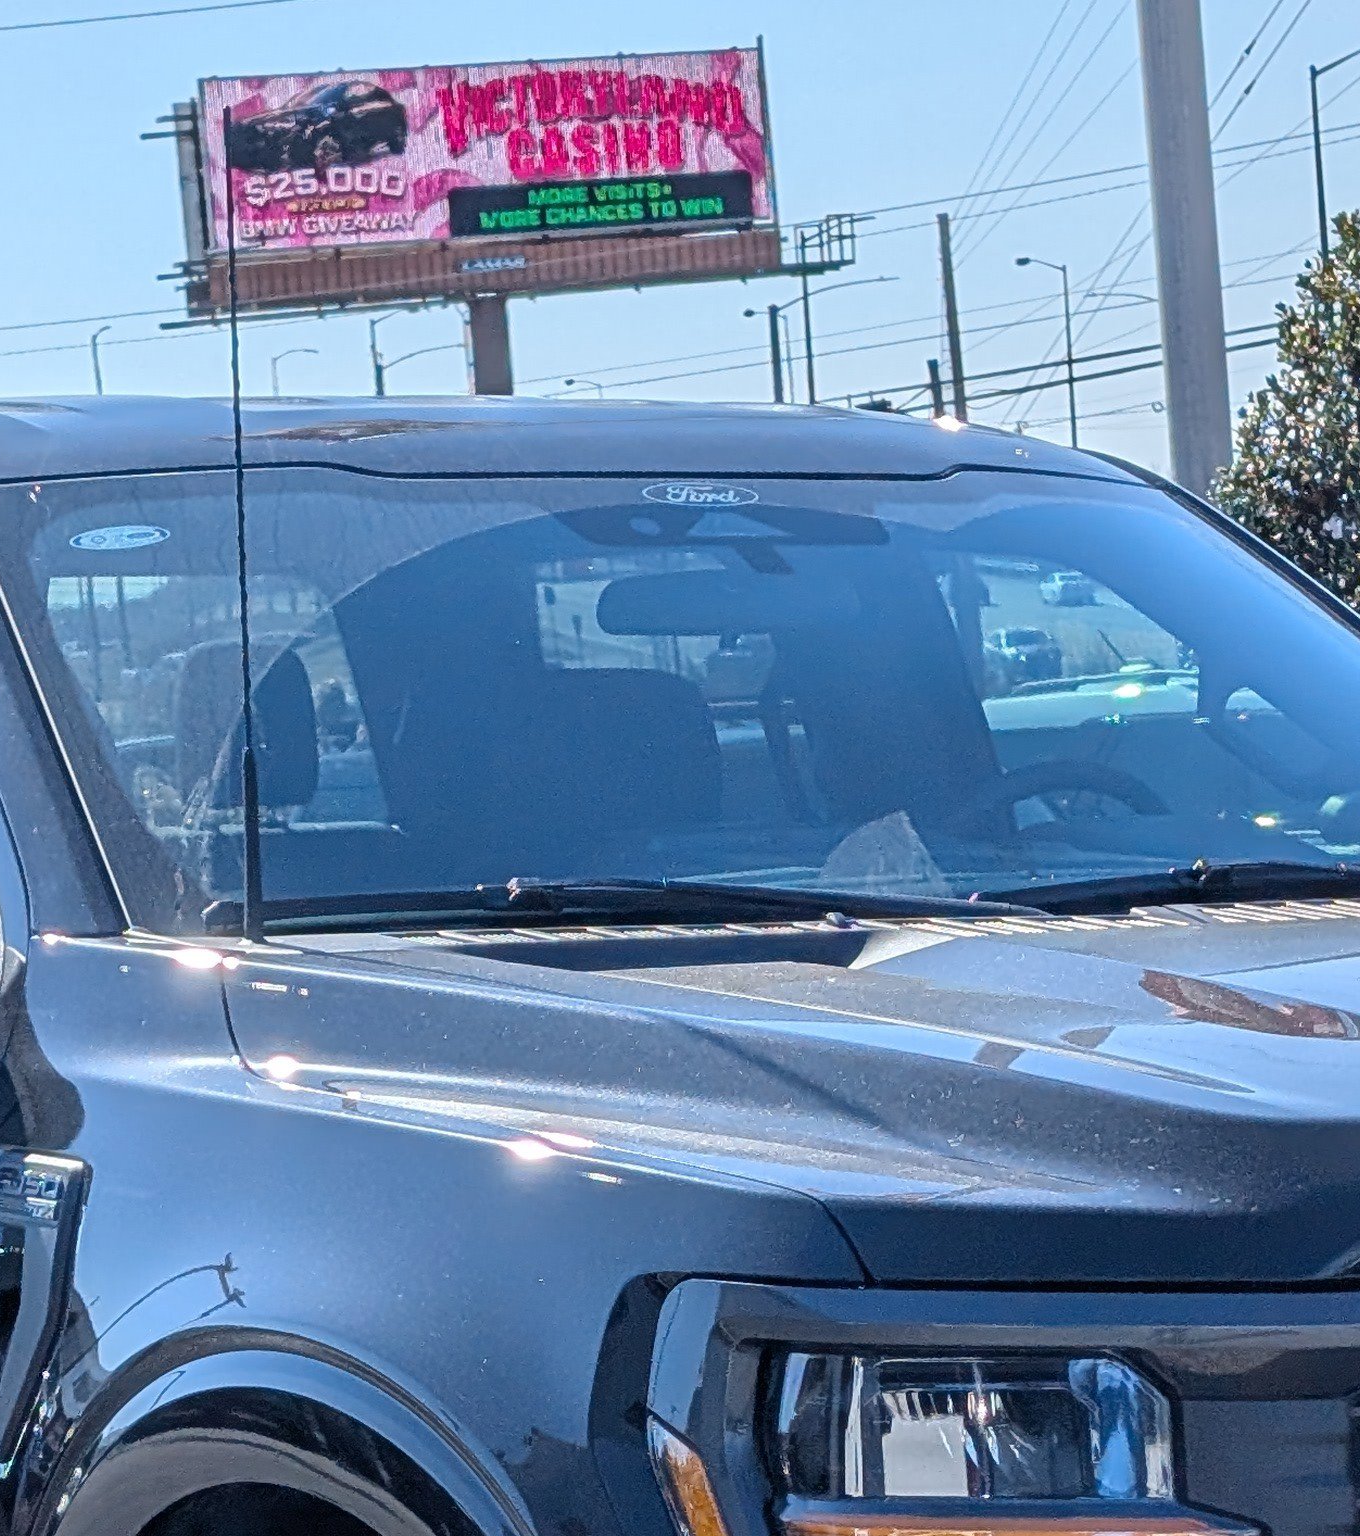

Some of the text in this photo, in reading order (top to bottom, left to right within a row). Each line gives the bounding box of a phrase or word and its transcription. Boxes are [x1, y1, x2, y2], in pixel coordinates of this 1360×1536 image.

[507, 119, 683, 179] CASINO
[528, 187, 588, 206] MORE
[479, 196, 724, 228] MORE CHANCES TO WIN
[666, 485, 741, 503] Ford
